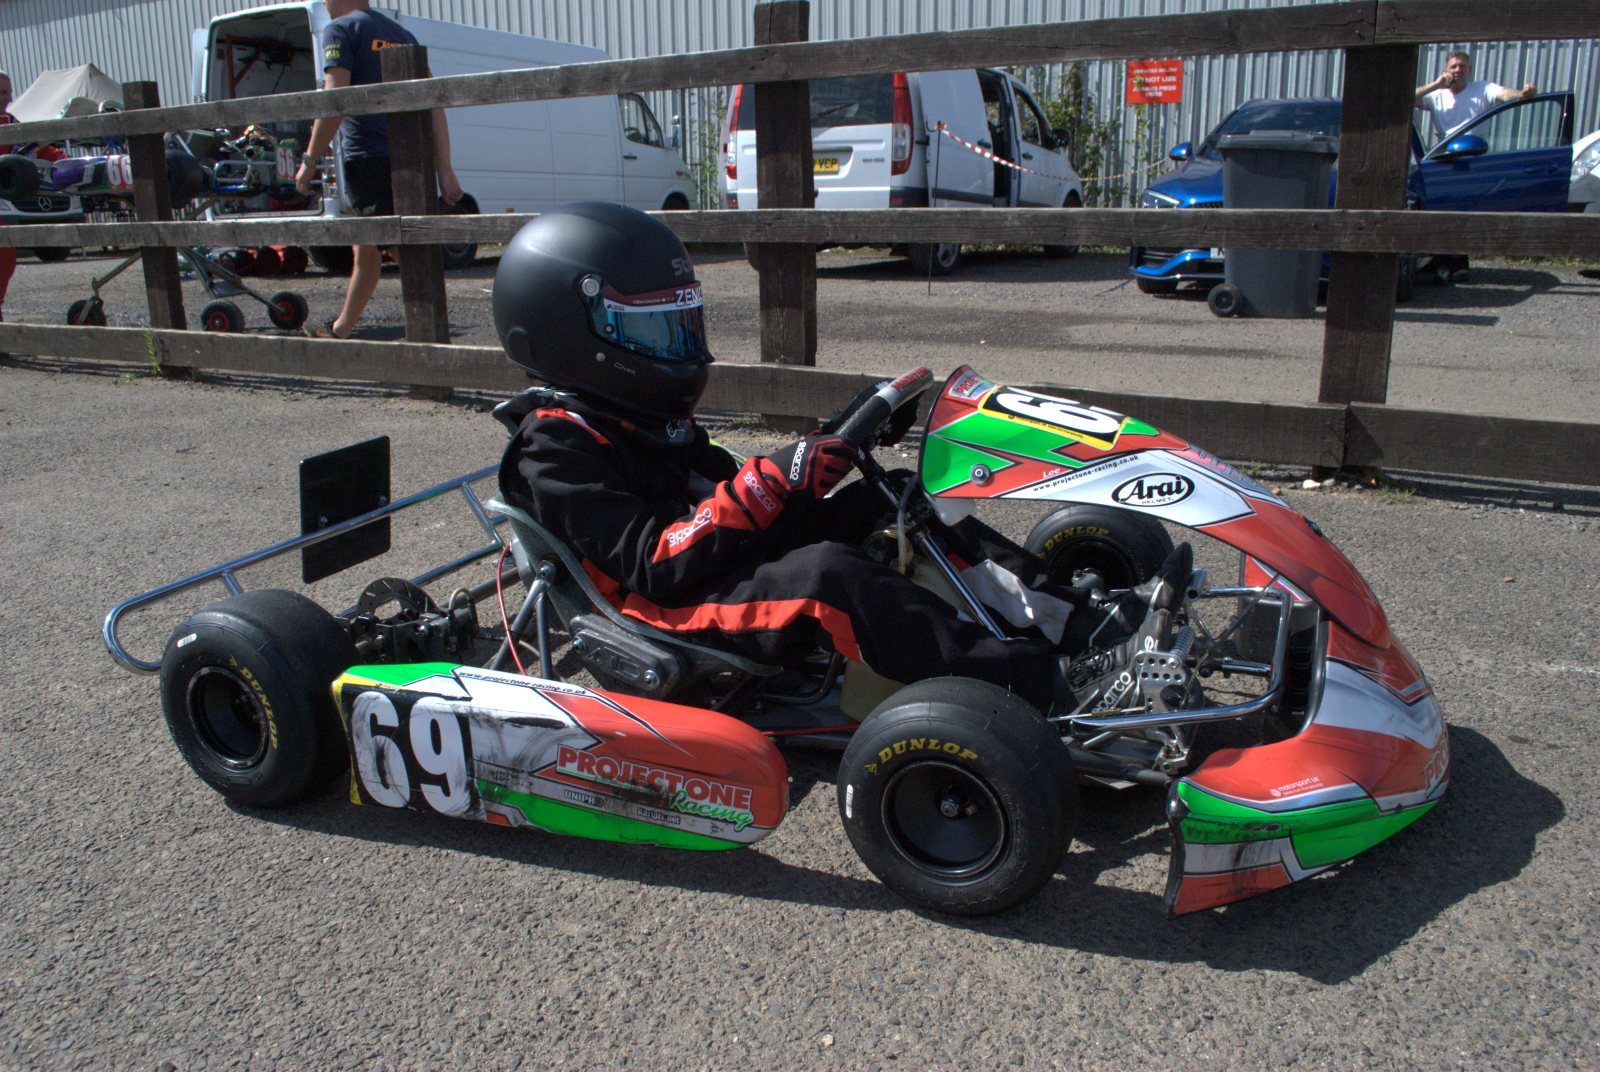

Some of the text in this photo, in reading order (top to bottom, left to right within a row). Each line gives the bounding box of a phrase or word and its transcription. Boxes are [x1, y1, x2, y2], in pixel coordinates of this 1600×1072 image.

[276, 151, 295, 175] 66
[789, 441, 807, 481] sparco
[1032, 455, 1139, 492] www.projectone-racing.co.uk
[1043, 467, 1061, 479] Lee
[742, 471, 776, 512] sparco
[1119, 474, 1185, 501] Arai
[667, 507, 713, 548] sparco
[1044, 526, 1110, 550] DUNLOP
[459, 671, 587, 695] www.projectone-racing.co.uk
[1092, 671, 1132, 712] parco
[240, 666, 277, 749] DUNLOP
[351, 691, 471, 816] 69
[878, 737, 979, 764] DUNLOP
[669, 789, 754, 832] Racing
